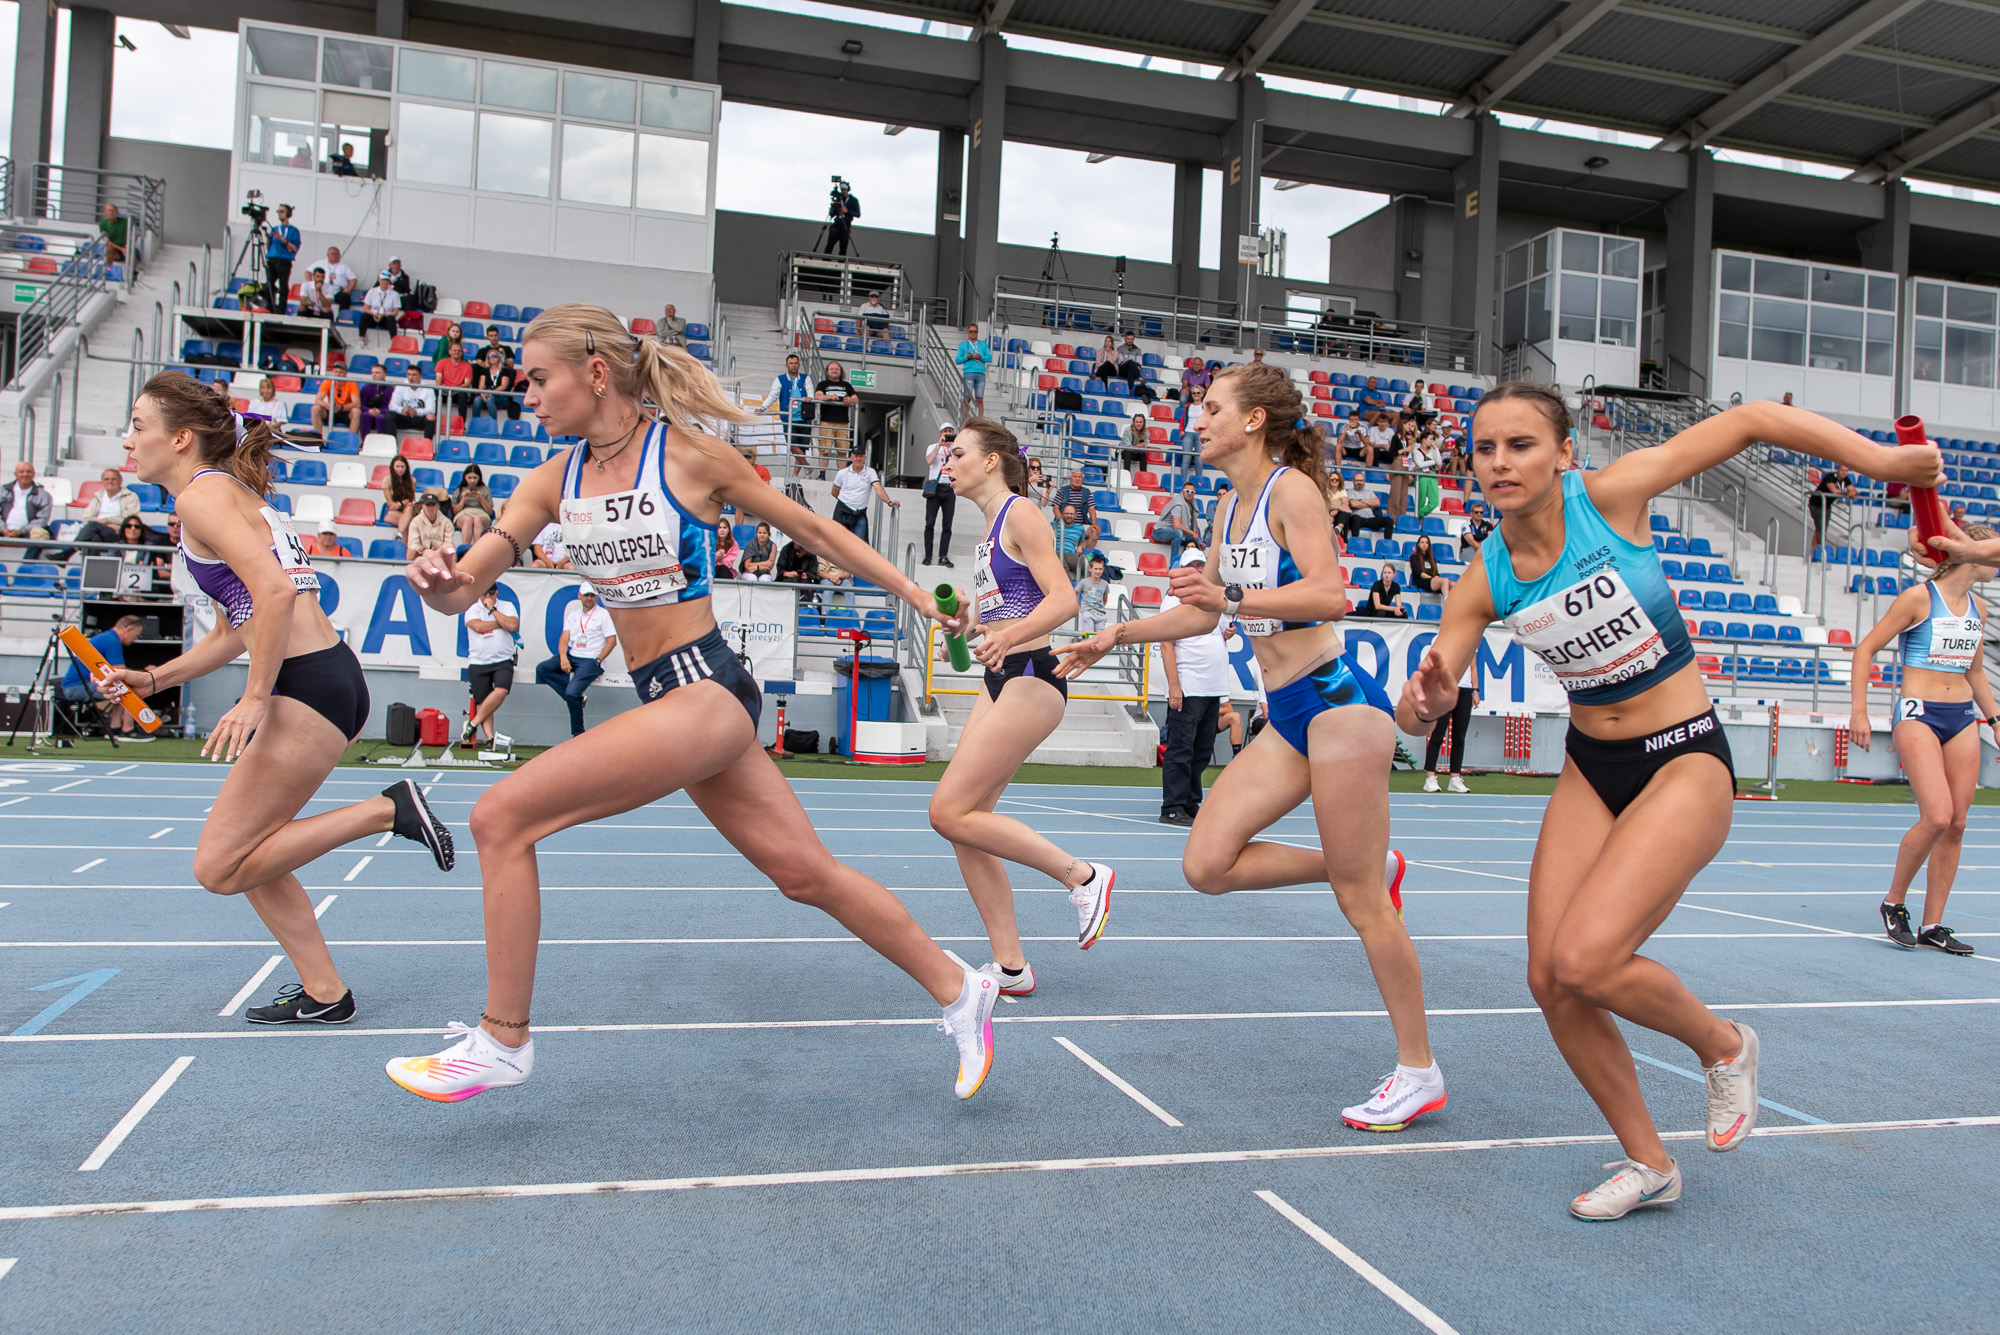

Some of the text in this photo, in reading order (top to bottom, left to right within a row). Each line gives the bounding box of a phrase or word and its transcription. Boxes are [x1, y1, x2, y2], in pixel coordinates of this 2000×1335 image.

[974, 117, 982, 150] E
[1230, 155, 1241, 186] E
[1465, 190, 1478, 219] E
[605, 492, 655, 522] 576
[566, 532, 669, 567] TROCHOLEPSZA
[1230, 548, 1260, 568] 571
[1574, 545, 1611, 571] WMLKS
[128, 573, 140, 589] 2
[294, 577, 317, 587] RADOM
[627, 579, 662, 598] 2022
[1564, 575, 1616, 617] 670
[1249, 622, 1266, 633] 2022
[1523, 612, 1556, 634] mosir
[750, 633, 783, 643] precyzji
[1943, 638, 1978, 650] TUREK
[1228, 622, 1525, 703] RDOM
[1611, 659, 1649, 682] 2022
[1905, 699, 1919, 718] 2
[1644, 716, 1714, 753] NIKE PRO
